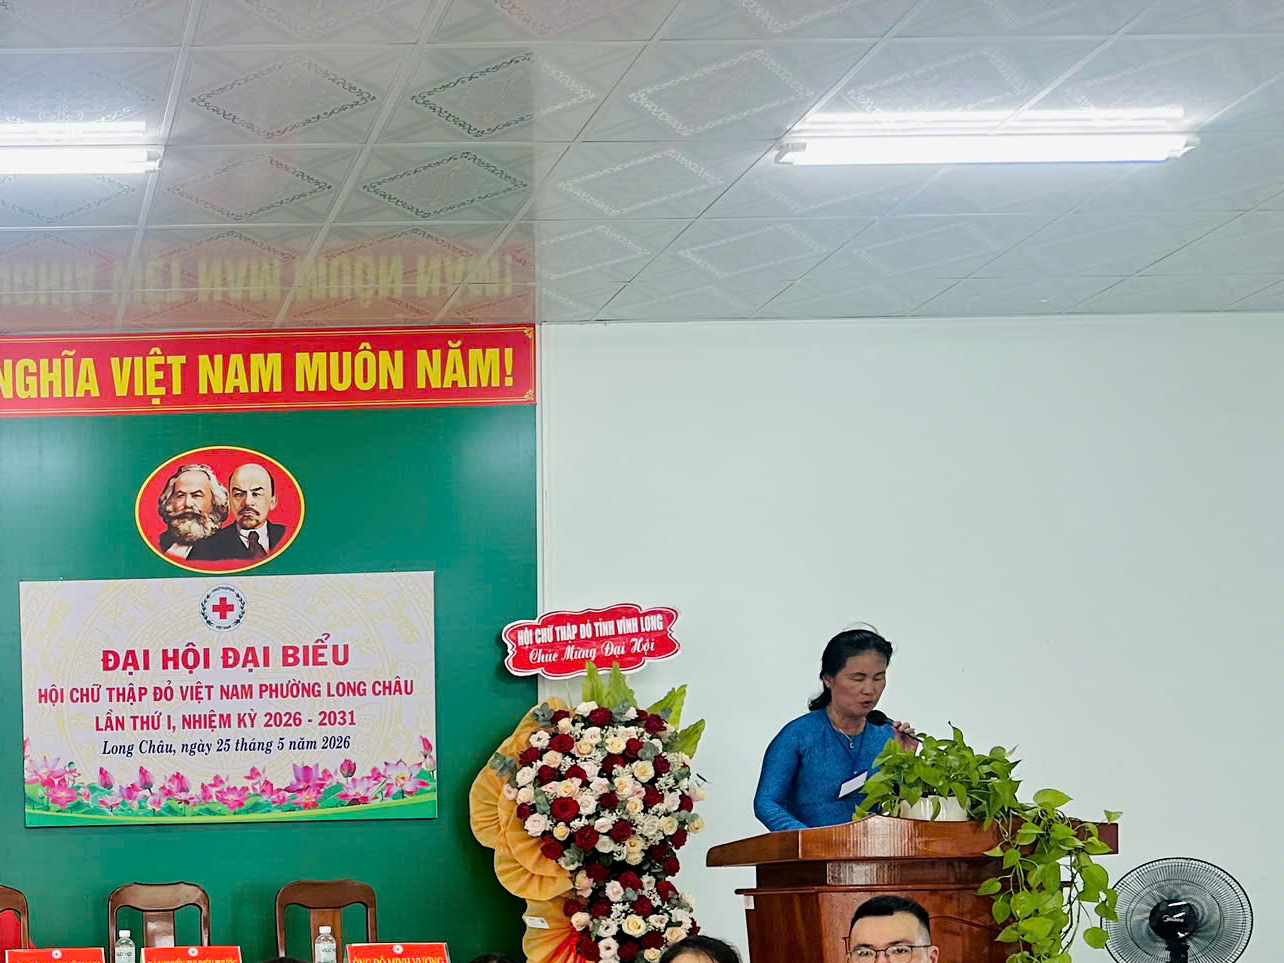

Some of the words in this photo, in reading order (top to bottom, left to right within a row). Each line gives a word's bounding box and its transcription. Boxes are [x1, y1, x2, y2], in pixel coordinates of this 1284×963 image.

[110, 347, 187, 405] VIỆT
[199, 352, 283, 394] NAM
[295, 341, 405, 392] MUÔN
[416, 340, 514, 389] NĂM!
[517, 627, 533, 648] HỘI
[536, 625, 554, 644] CHỮ
[555, 623, 577, 643] THẬP
[579, 619, 593, 639] ĐỎ
[593, 618, 615, 637] TỈNH
[616, 616, 638, 635] VĨNH
[640, 614, 664, 632] LONG
[101, 649, 150, 675] ĐẠI
[161, 642, 210, 674] HỘI
[221, 646, 270, 673] ĐẠI
[282, 632, 349, 667] BIỂU
[529, 648, 558, 664] Chúc
[561, 644, 597, 661] Mừng
[600, 640, 626, 658] Đại
[629, 638, 655, 655] Hội
[38, 684, 64, 707] HỘI
[69, 683, 101, 703] CHỮ
[106, 682, 148, 706] THẬP
[152, 680, 174, 702] ĐỎ
[179, 681, 214, 704] VIỆT
[220, 684, 253, 700] NAM
[259, 679, 321, 699] PHƯỜNG
[327, 680, 367, 698] LONG
[371, 675, 414, 696] CHÂU
[95, 709, 125, 732] LẦN
[130, 711, 163, 731] THỨ
[167, 714, 177, 733] I,
[181, 709, 232, 732] NHIỆM
[237, 708, 258, 729] KỲ
[263, 711, 302, 728] 2026
[318, 710, 356, 726] 2031
[102, 740, 135, 758] Long
[138, 739, 177, 756] Châu,
[181, 739, 212, 756] ngày
[216, 738, 231, 752] 25
[235, 737, 273, 755] tháng
[277, 737, 285, 751] 5
[289, 737, 317, 751] năm
[321, 736, 351, 750] 2026
